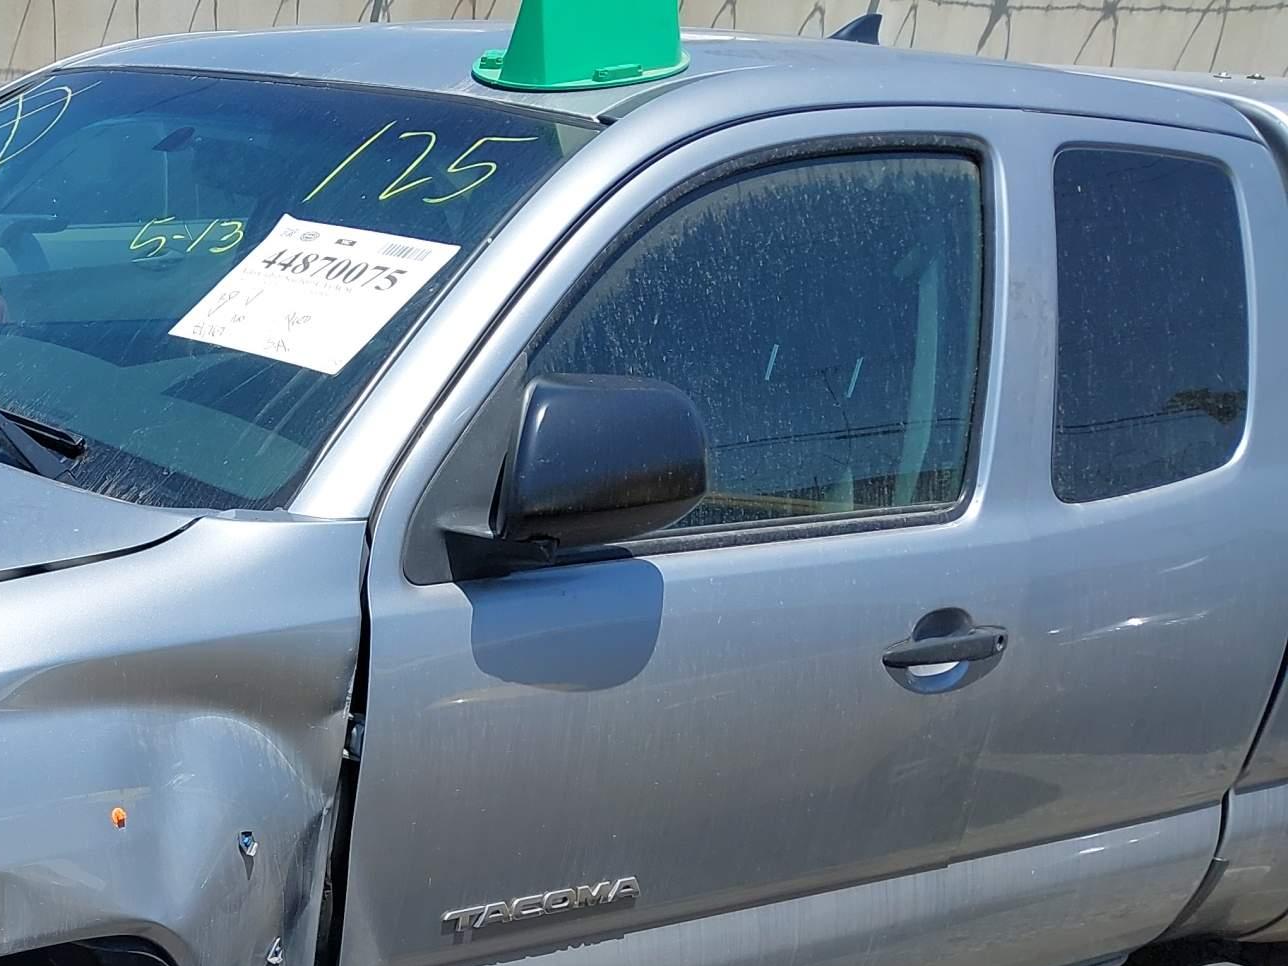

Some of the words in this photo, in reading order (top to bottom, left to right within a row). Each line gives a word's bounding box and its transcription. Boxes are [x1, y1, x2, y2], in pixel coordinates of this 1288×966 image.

[302, 120, 540, 203] 125
[262, 248, 409, 292] 44870075
[441, 876, 641, 932] TACOMA
